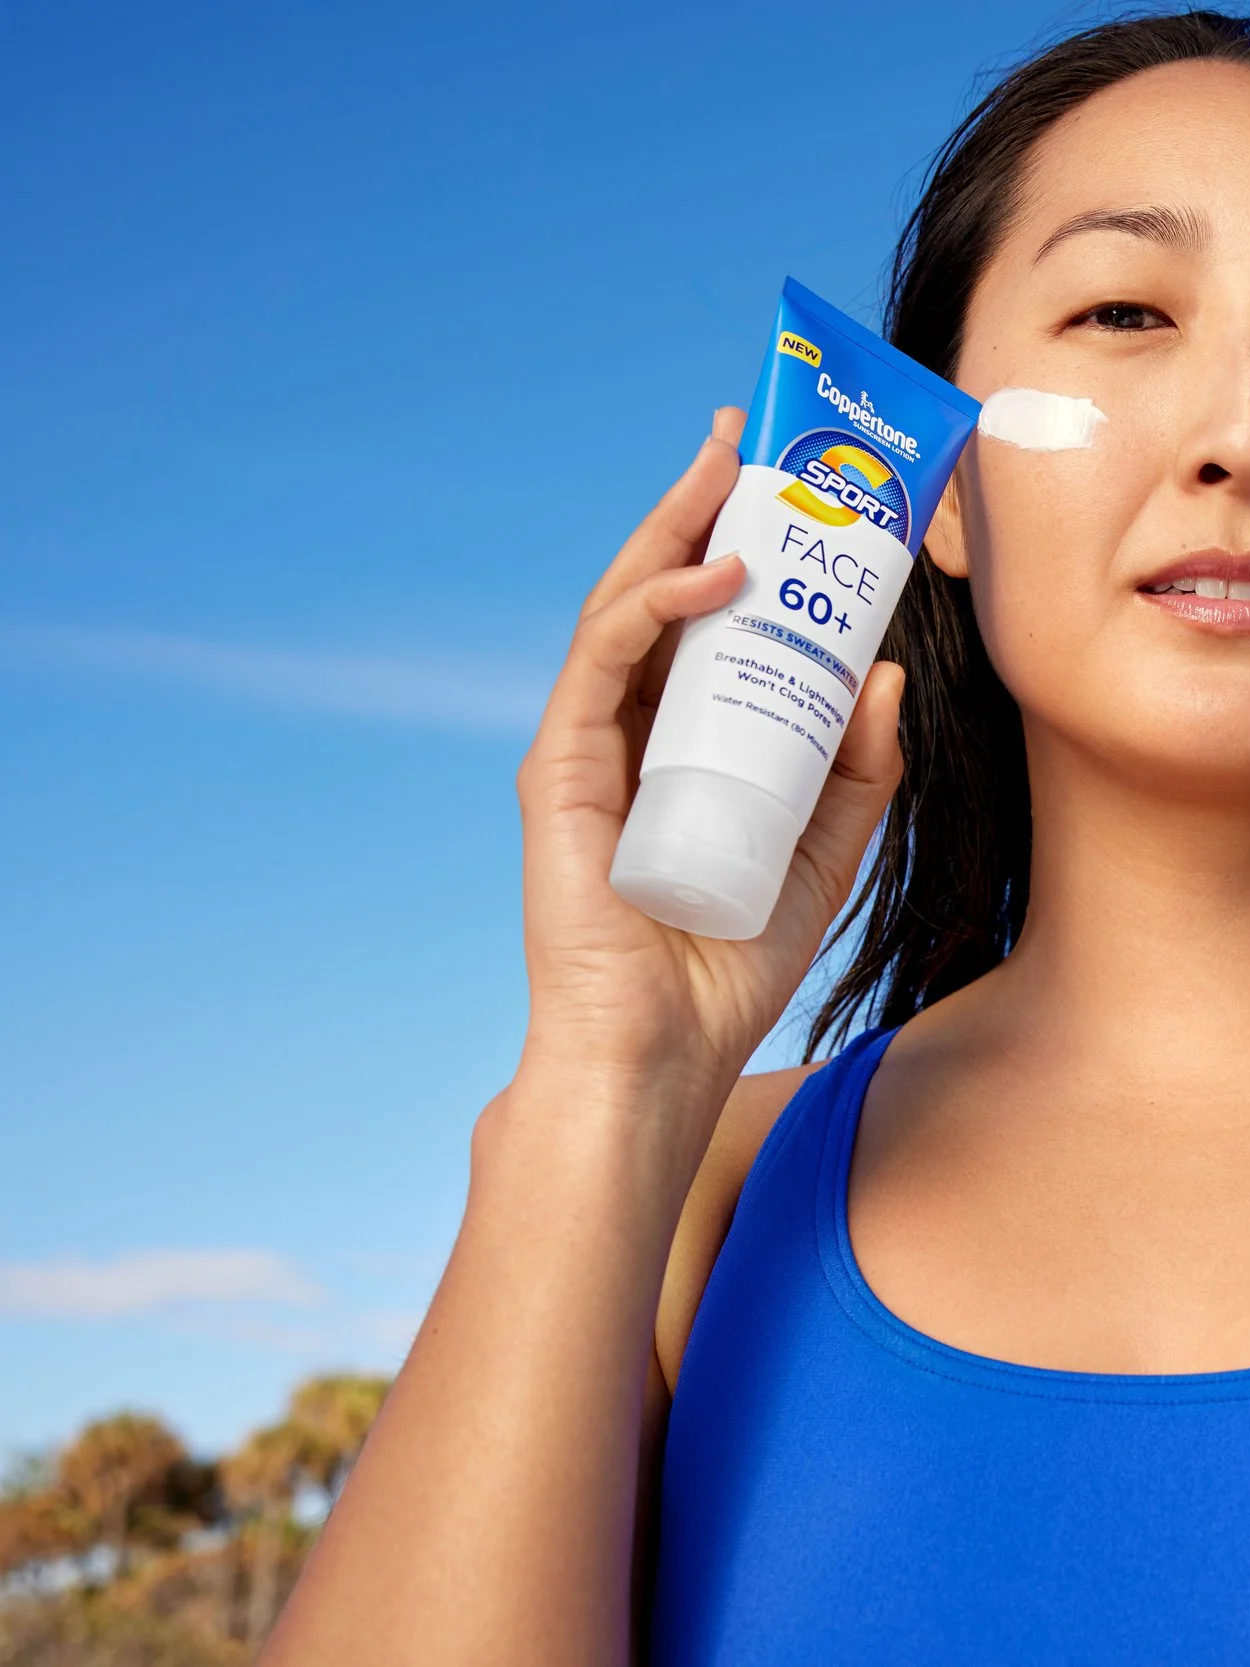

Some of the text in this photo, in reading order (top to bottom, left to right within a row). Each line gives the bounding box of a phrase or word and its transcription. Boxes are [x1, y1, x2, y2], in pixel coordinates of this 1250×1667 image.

[783, 337, 818, 360] NEW
[853, 421, 915, 463] SUNSCREEN LOTION
[799, 460, 899, 527] SPORT
[781, 524, 879, 605] FACE
[779, 578, 852, 633] 60+
[732, 615, 784, 638] RESISTS
[786, 633, 826, 660] SWEAT
[715, 651, 785, 680] Breathable
[788, 676, 797, 687] &
[712, 693, 743, 706] Water
[746, 700, 789, 726] Resistant
[791, 722, 806, 737] (80
[737, 670, 832, 729] Won't Clog Pores
